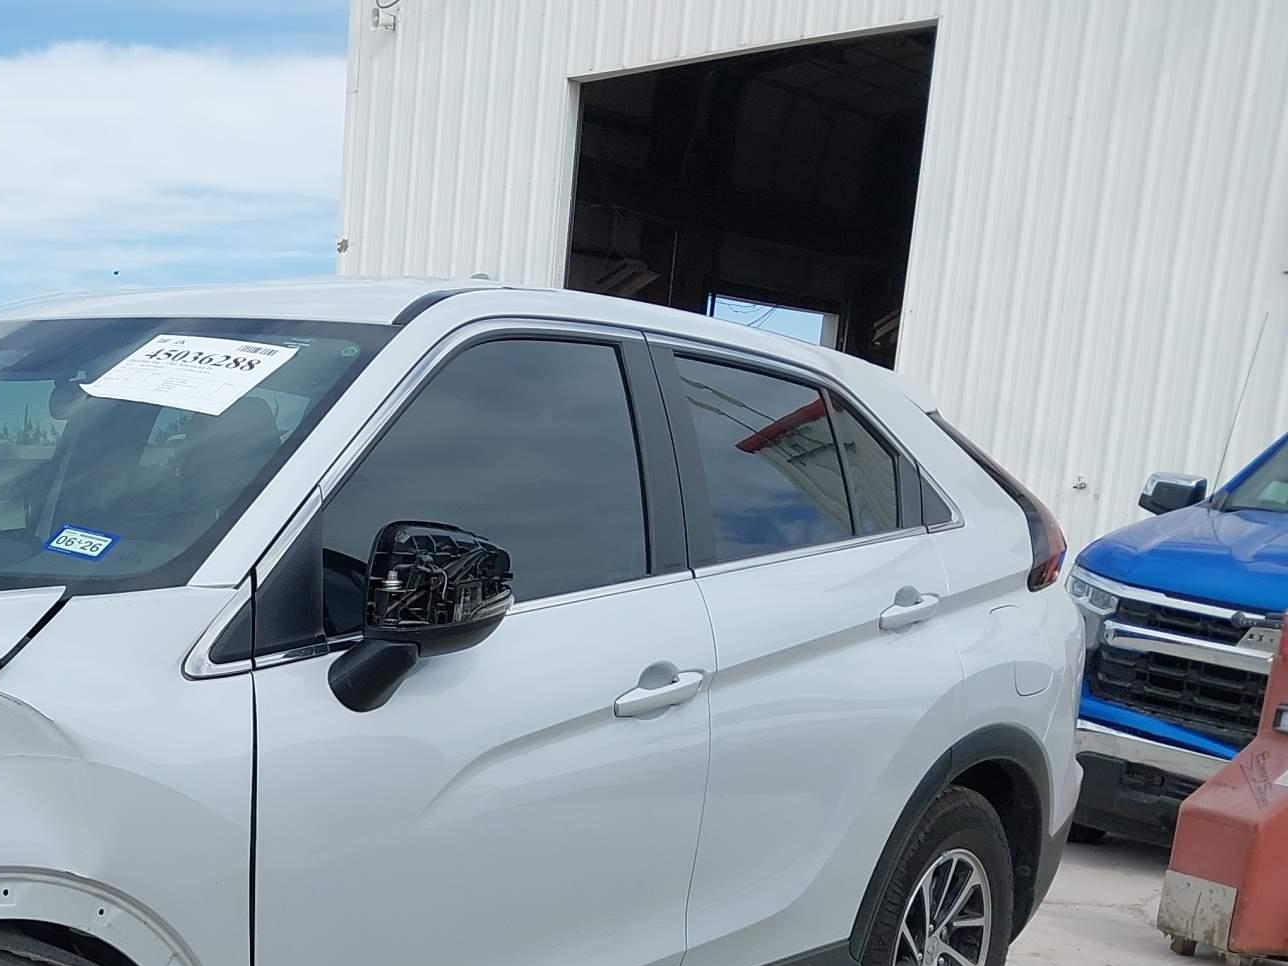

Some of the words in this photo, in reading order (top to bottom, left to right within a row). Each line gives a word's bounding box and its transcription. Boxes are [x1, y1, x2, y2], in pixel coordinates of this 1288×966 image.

[144, 347, 261, 372] 45036288
[55, 535, 77, 547] 06
[80, 540, 102, 552] 26
